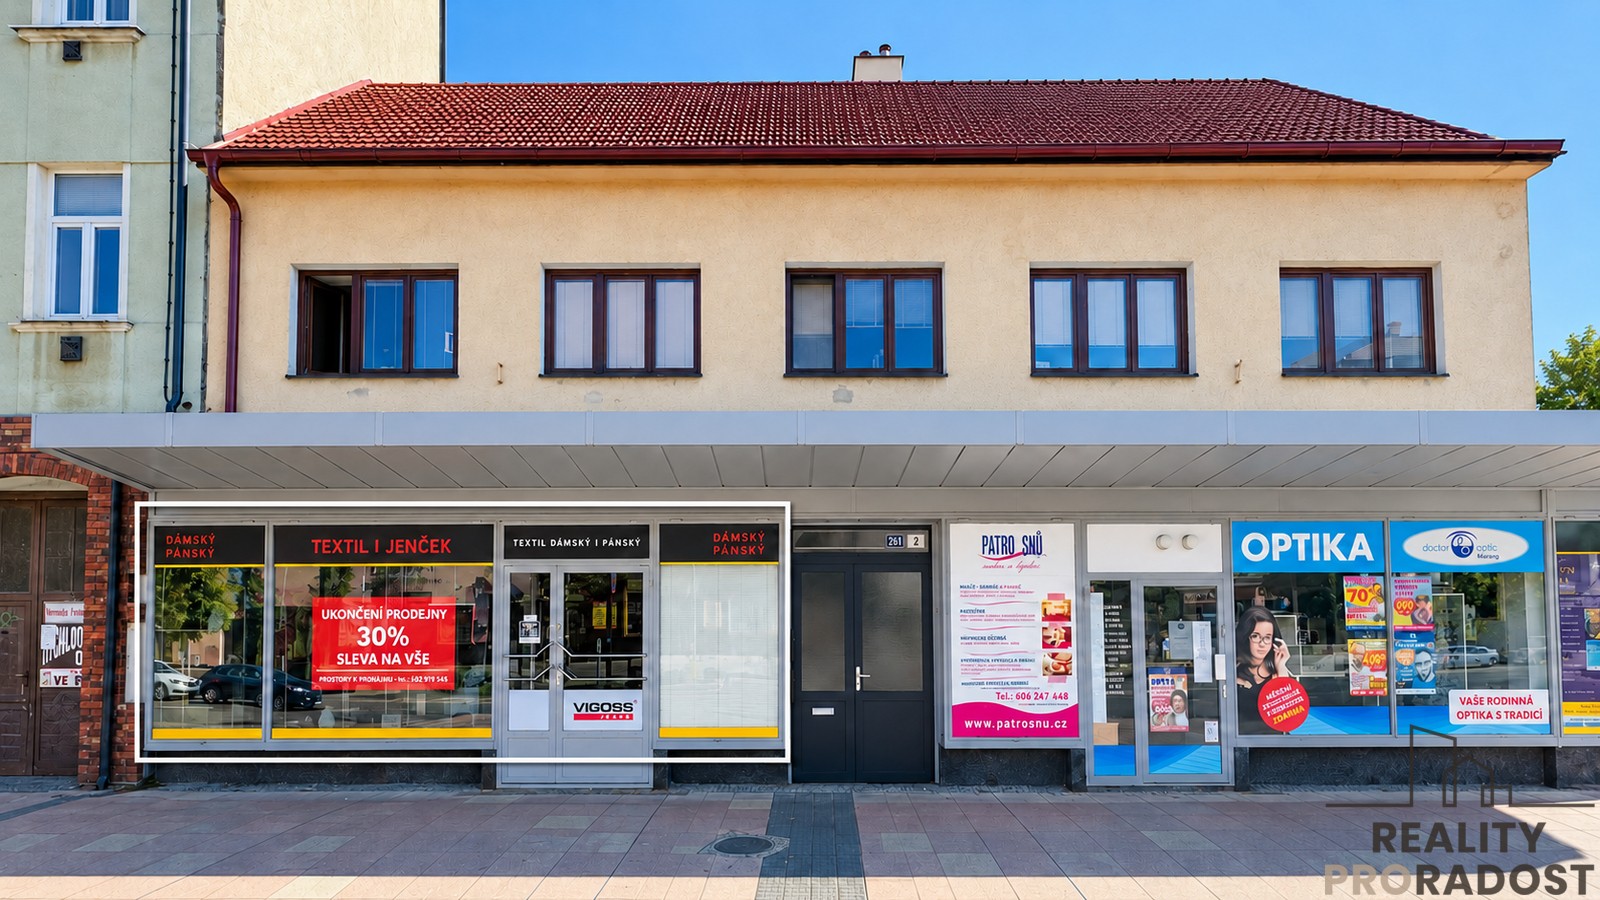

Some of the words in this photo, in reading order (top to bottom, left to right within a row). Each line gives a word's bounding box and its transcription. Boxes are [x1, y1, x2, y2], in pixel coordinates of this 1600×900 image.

[165, 532, 216, 546] DÁMSKÝ
[513, 537, 547, 548] TEXTIL
[550, 536, 591, 548] DÁMSKÝ
[595, 537, 599, 548] I
[602, 536, 642, 548] PÁNSKÝ
[713, 531, 766, 543] DÁMSKÝ
[888, 536, 902, 546] 261
[913, 536, 919, 546] 2
[982, 535, 1015, 556] PATRO
[1022, 530, 1043, 557] SNŮ
[311, 538, 369, 554] TEXTIL
[375, 538, 380, 554] I
[385, 534, 452, 555] JENČEK
[713, 543, 765, 556] PÁNSKÝ
[1241, 532, 1374, 562] OPTIKA
[1422, 543, 1450, 552] doctor
[165, 545, 215, 559] PÁNSKÝ
[321, 605, 383, 620] UKONČENÍ
[386, 608, 448, 620] PRODEJNY
[357, 626, 410, 647] 30%
[336, 652, 379, 665] SLEVA
[381, 653, 402, 665] NA
[404, 650, 430, 665] VŠE
[319, 676, 352, 684] PROSTORY
[996, 691, 1013, 701] Tel.:
[1015, 691, 1032, 701] 606
[1034, 691, 1050, 701] 247
[1052, 691, 1069, 701] 448
[1459, 694, 1485, 706] VAŠE
[1487, 694, 1534, 706] RODINNÁ
[573, 702, 634, 713] VIGOSS
[1456, 710, 1494, 720] OPTIKA
[1495, 710, 1502, 720] S
[1504, 707, 1543, 720] TRADICÍ
[964, 717, 1068, 731] www.patrosnu.cz
